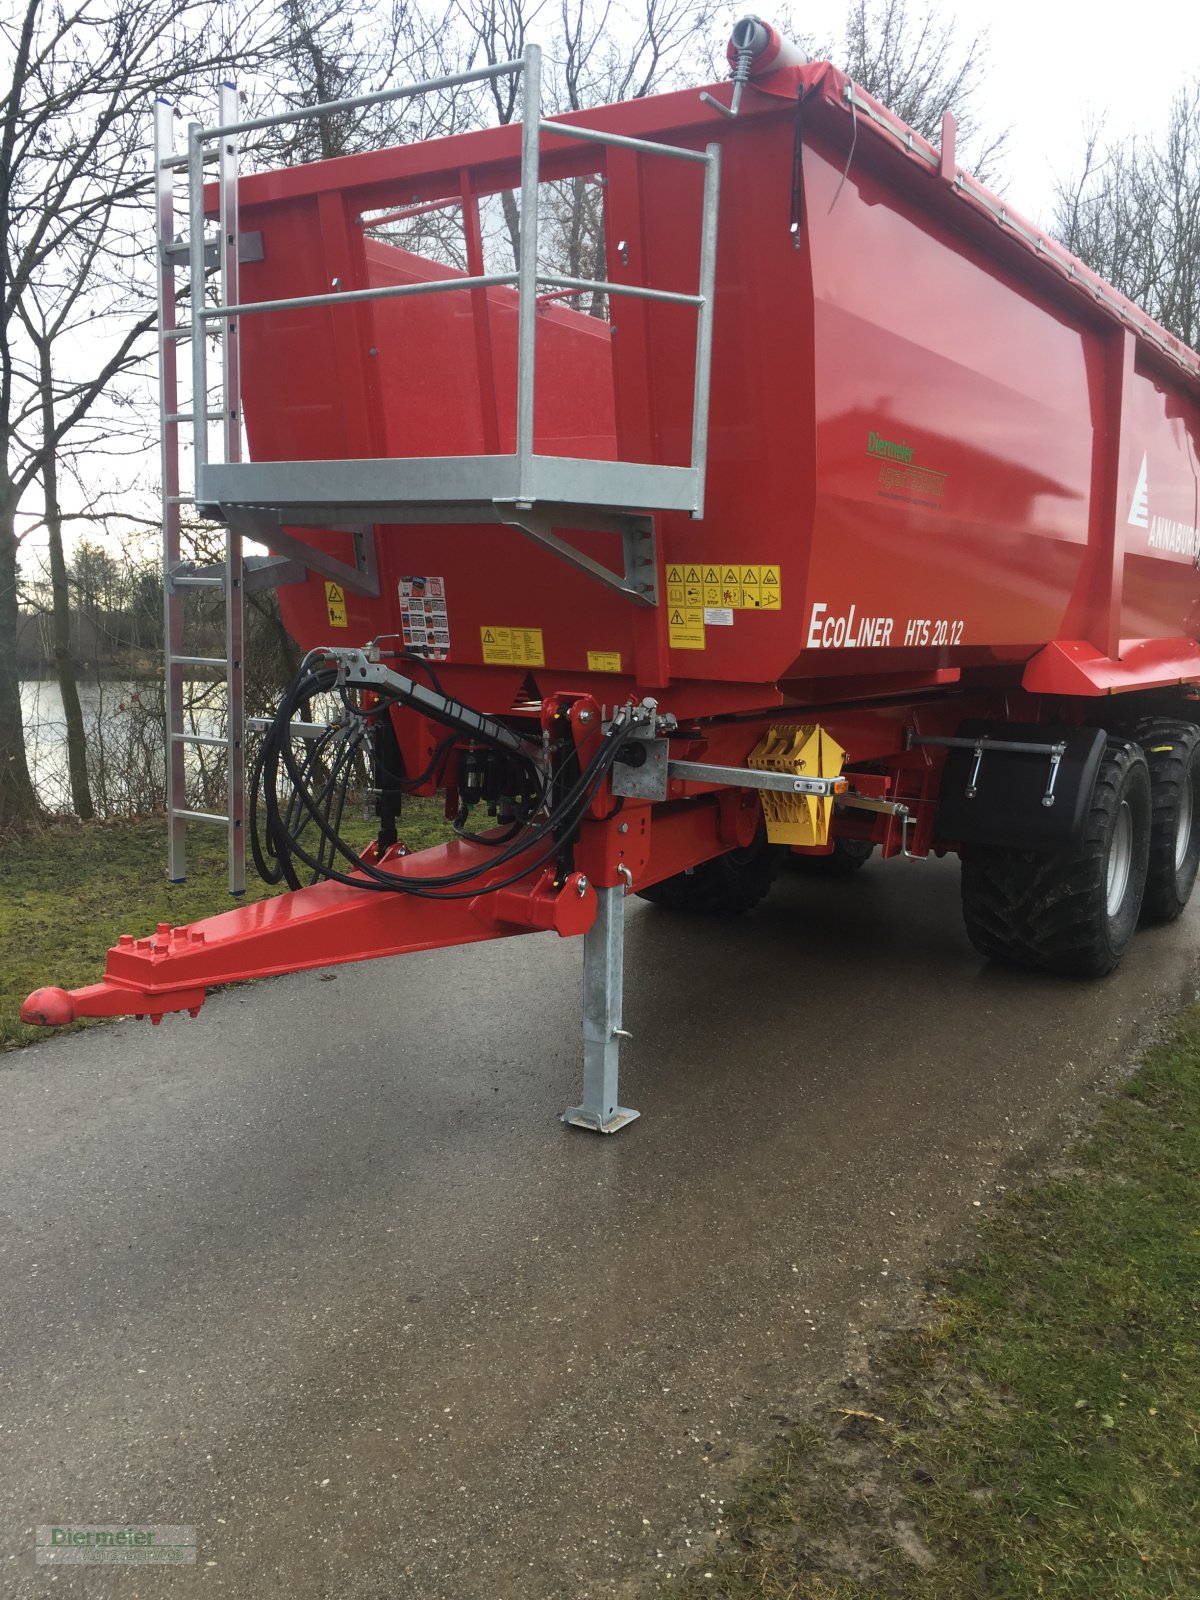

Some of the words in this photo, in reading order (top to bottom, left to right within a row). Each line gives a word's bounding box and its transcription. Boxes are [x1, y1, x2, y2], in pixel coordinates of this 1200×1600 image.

[868, 432, 914, 461] Diermeier
[904, 619, 932, 646] HTS
[931, 620, 964, 646] 20.12
